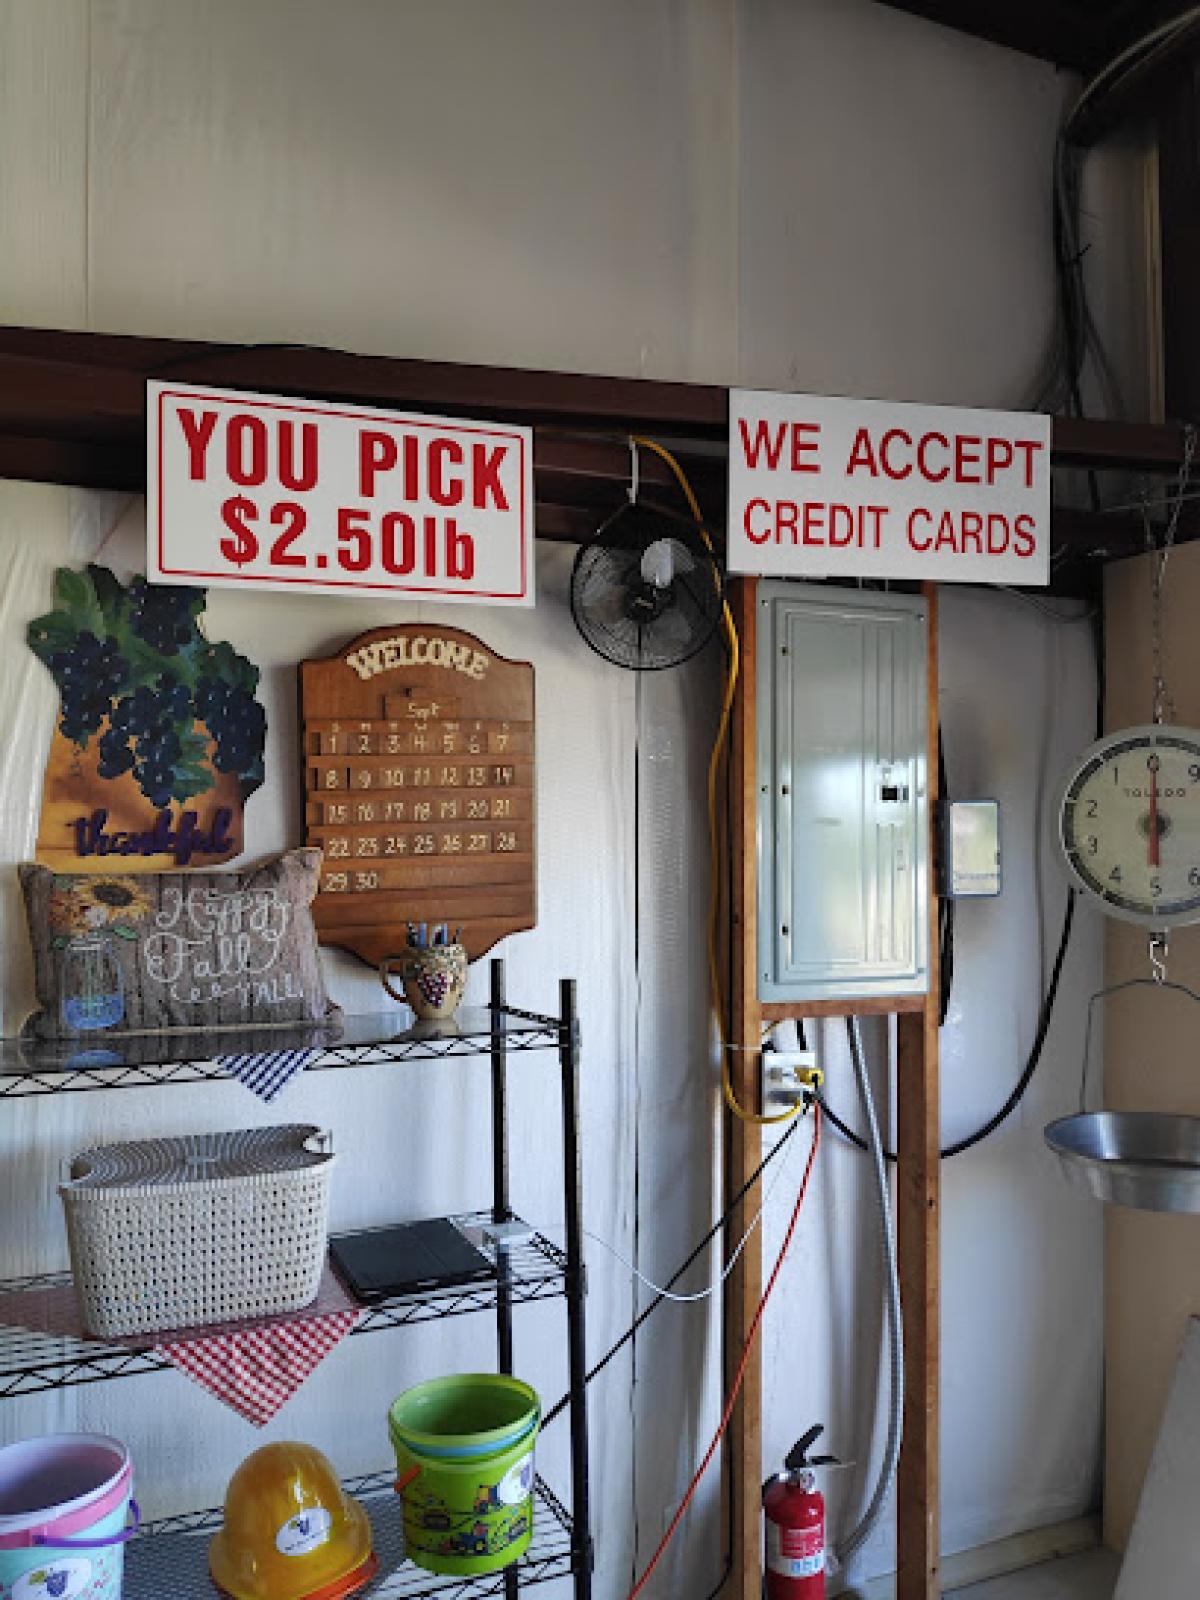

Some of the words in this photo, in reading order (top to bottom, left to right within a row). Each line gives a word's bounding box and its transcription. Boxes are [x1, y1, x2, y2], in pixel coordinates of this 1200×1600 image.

[176, 408, 319, 492] YOU
[359, 429, 510, 512] PICK
[738, 418, 821, 473] WE
[846, 426, 1044, 488] ACCEPT
[220, 493, 474, 580] $2.50lb
[743, 497, 889, 548] CREDIT
[906, 507, 1036, 557] CARDS
[347, 635, 490, 680] WELCOME
[329, 737, 337, 753] 1
[359, 735, 370, 753] 2
[389, 736, 399, 753] 3
[414, 736, 425, 751] 4
[444, 736, 454, 752] 5
[470, 735, 480, 753] 6
[497, 735, 508, 751] 7
[326, 770, 338, 788] 8
[359, 771, 371, 788] 9
[385, 769, 403, 785] 10
[414, 769, 430, 784] 11
[441, 769, 458, 785] 12
[468, 768, 486, 784] 13
[495, 767, 512, 784] 14
[1188, 764, 1200, 783] 9
[328, 805, 346, 823] 15
[359, 805, 372, 821] 16
[386, 803, 403, 820] 17
[414, 803, 431, 820] 18
[440, 802, 457, 819] 19
[468, 802, 489, 819] 20
[494, 800, 510, 816] 21
[1086, 800, 1097, 818] 2
[66, 808, 235, 865] thankful
[328, 839, 349, 857] 22
[359, 838, 377, 856] 23
[385, 838, 406, 854] 24
[414, 836, 434, 853] 25
[442, 835, 460, 852] 26
[470, 835, 489, 851] 27
[498, 833, 516, 850] 28
[1087, 835, 1097, 856] 3
[325, 873, 348, 891] 29
[356, 872, 377, 890] 30
[1109, 864, 1121, 882] 4
[1150, 876, 1162, 897] 5
